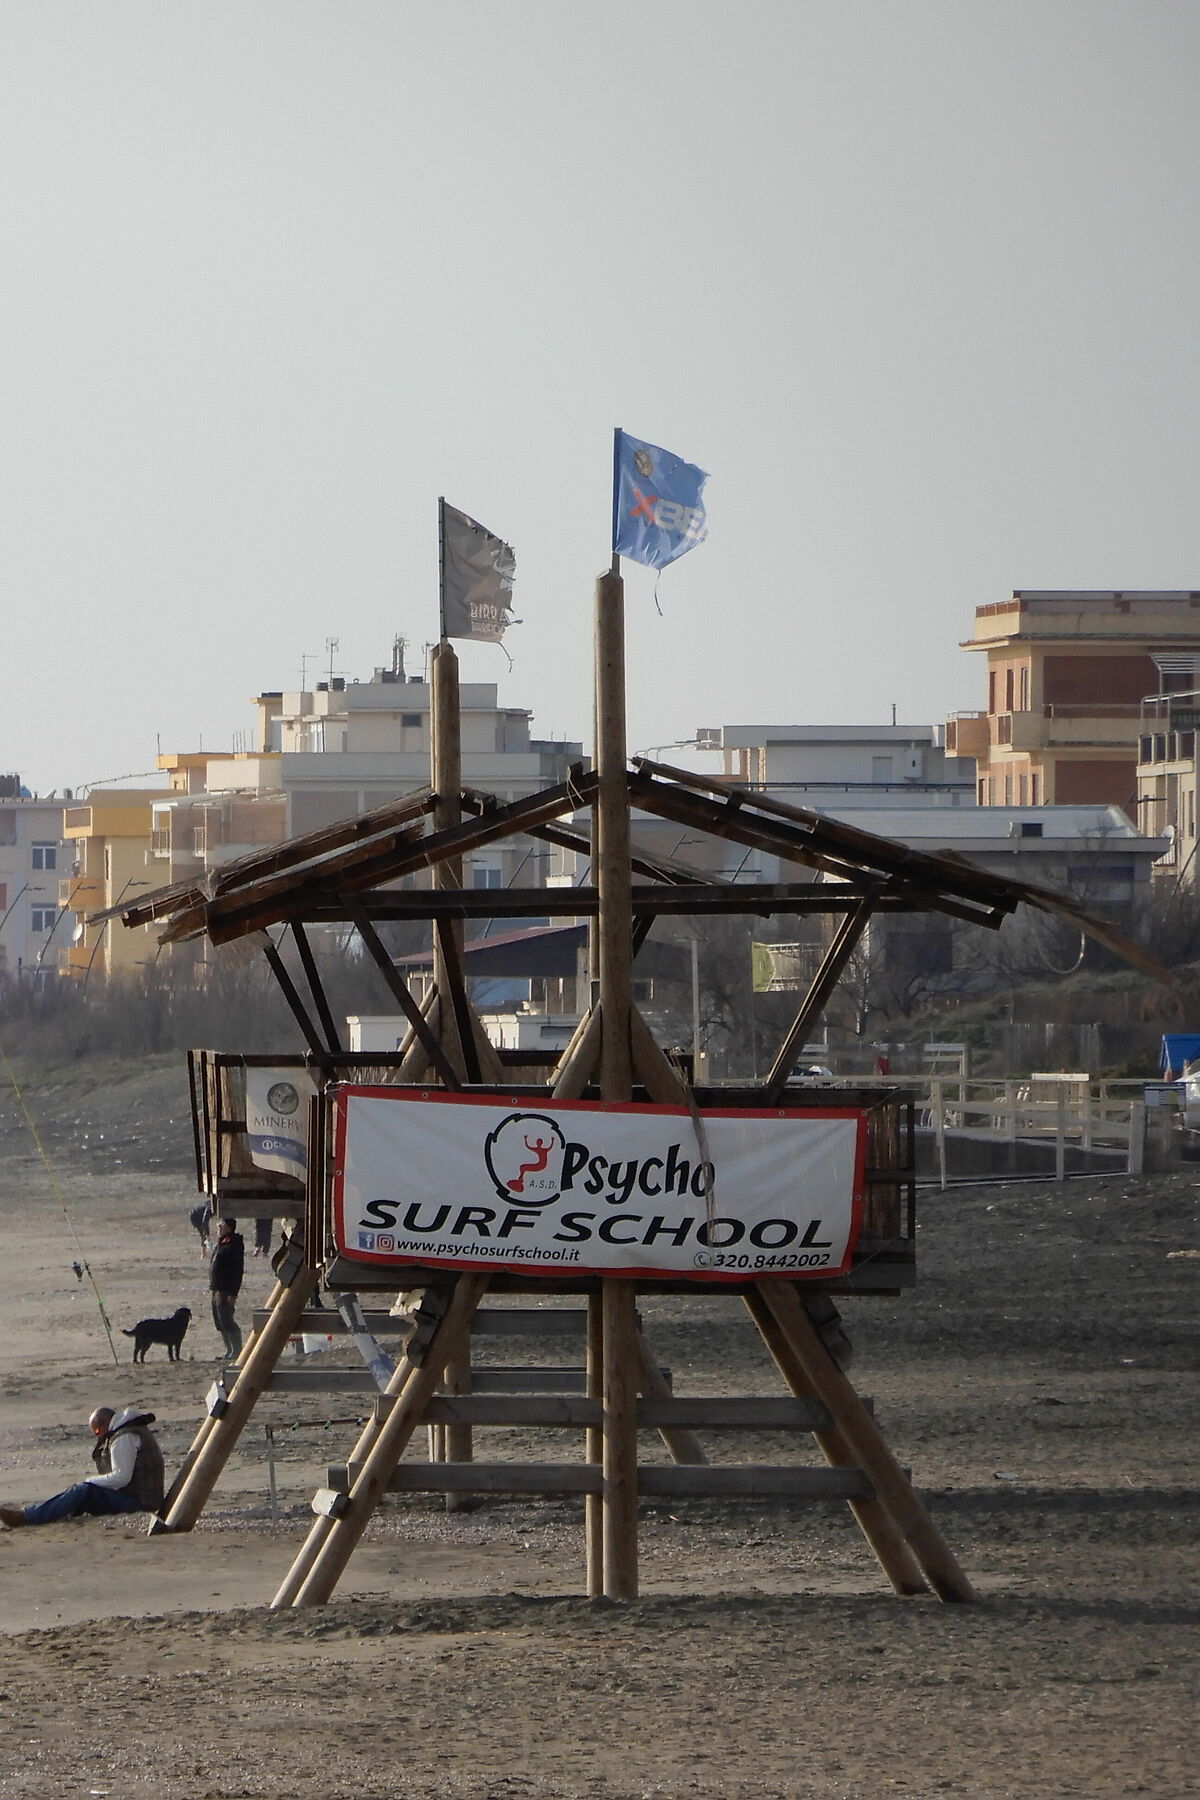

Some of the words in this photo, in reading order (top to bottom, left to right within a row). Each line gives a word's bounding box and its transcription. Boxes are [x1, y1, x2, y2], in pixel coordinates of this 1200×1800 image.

[528, 1178, 557, 1190] A.S.D.
[561, 1143, 715, 1205] Psycho
[358, 1199, 542, 1239] SURF
[552, 1211, 833, 1249] SCHOOL
[397, 1238, 580, 1262] www.psychosurfschool.it
[714, 1253, 831, 1269] 320.8442002
